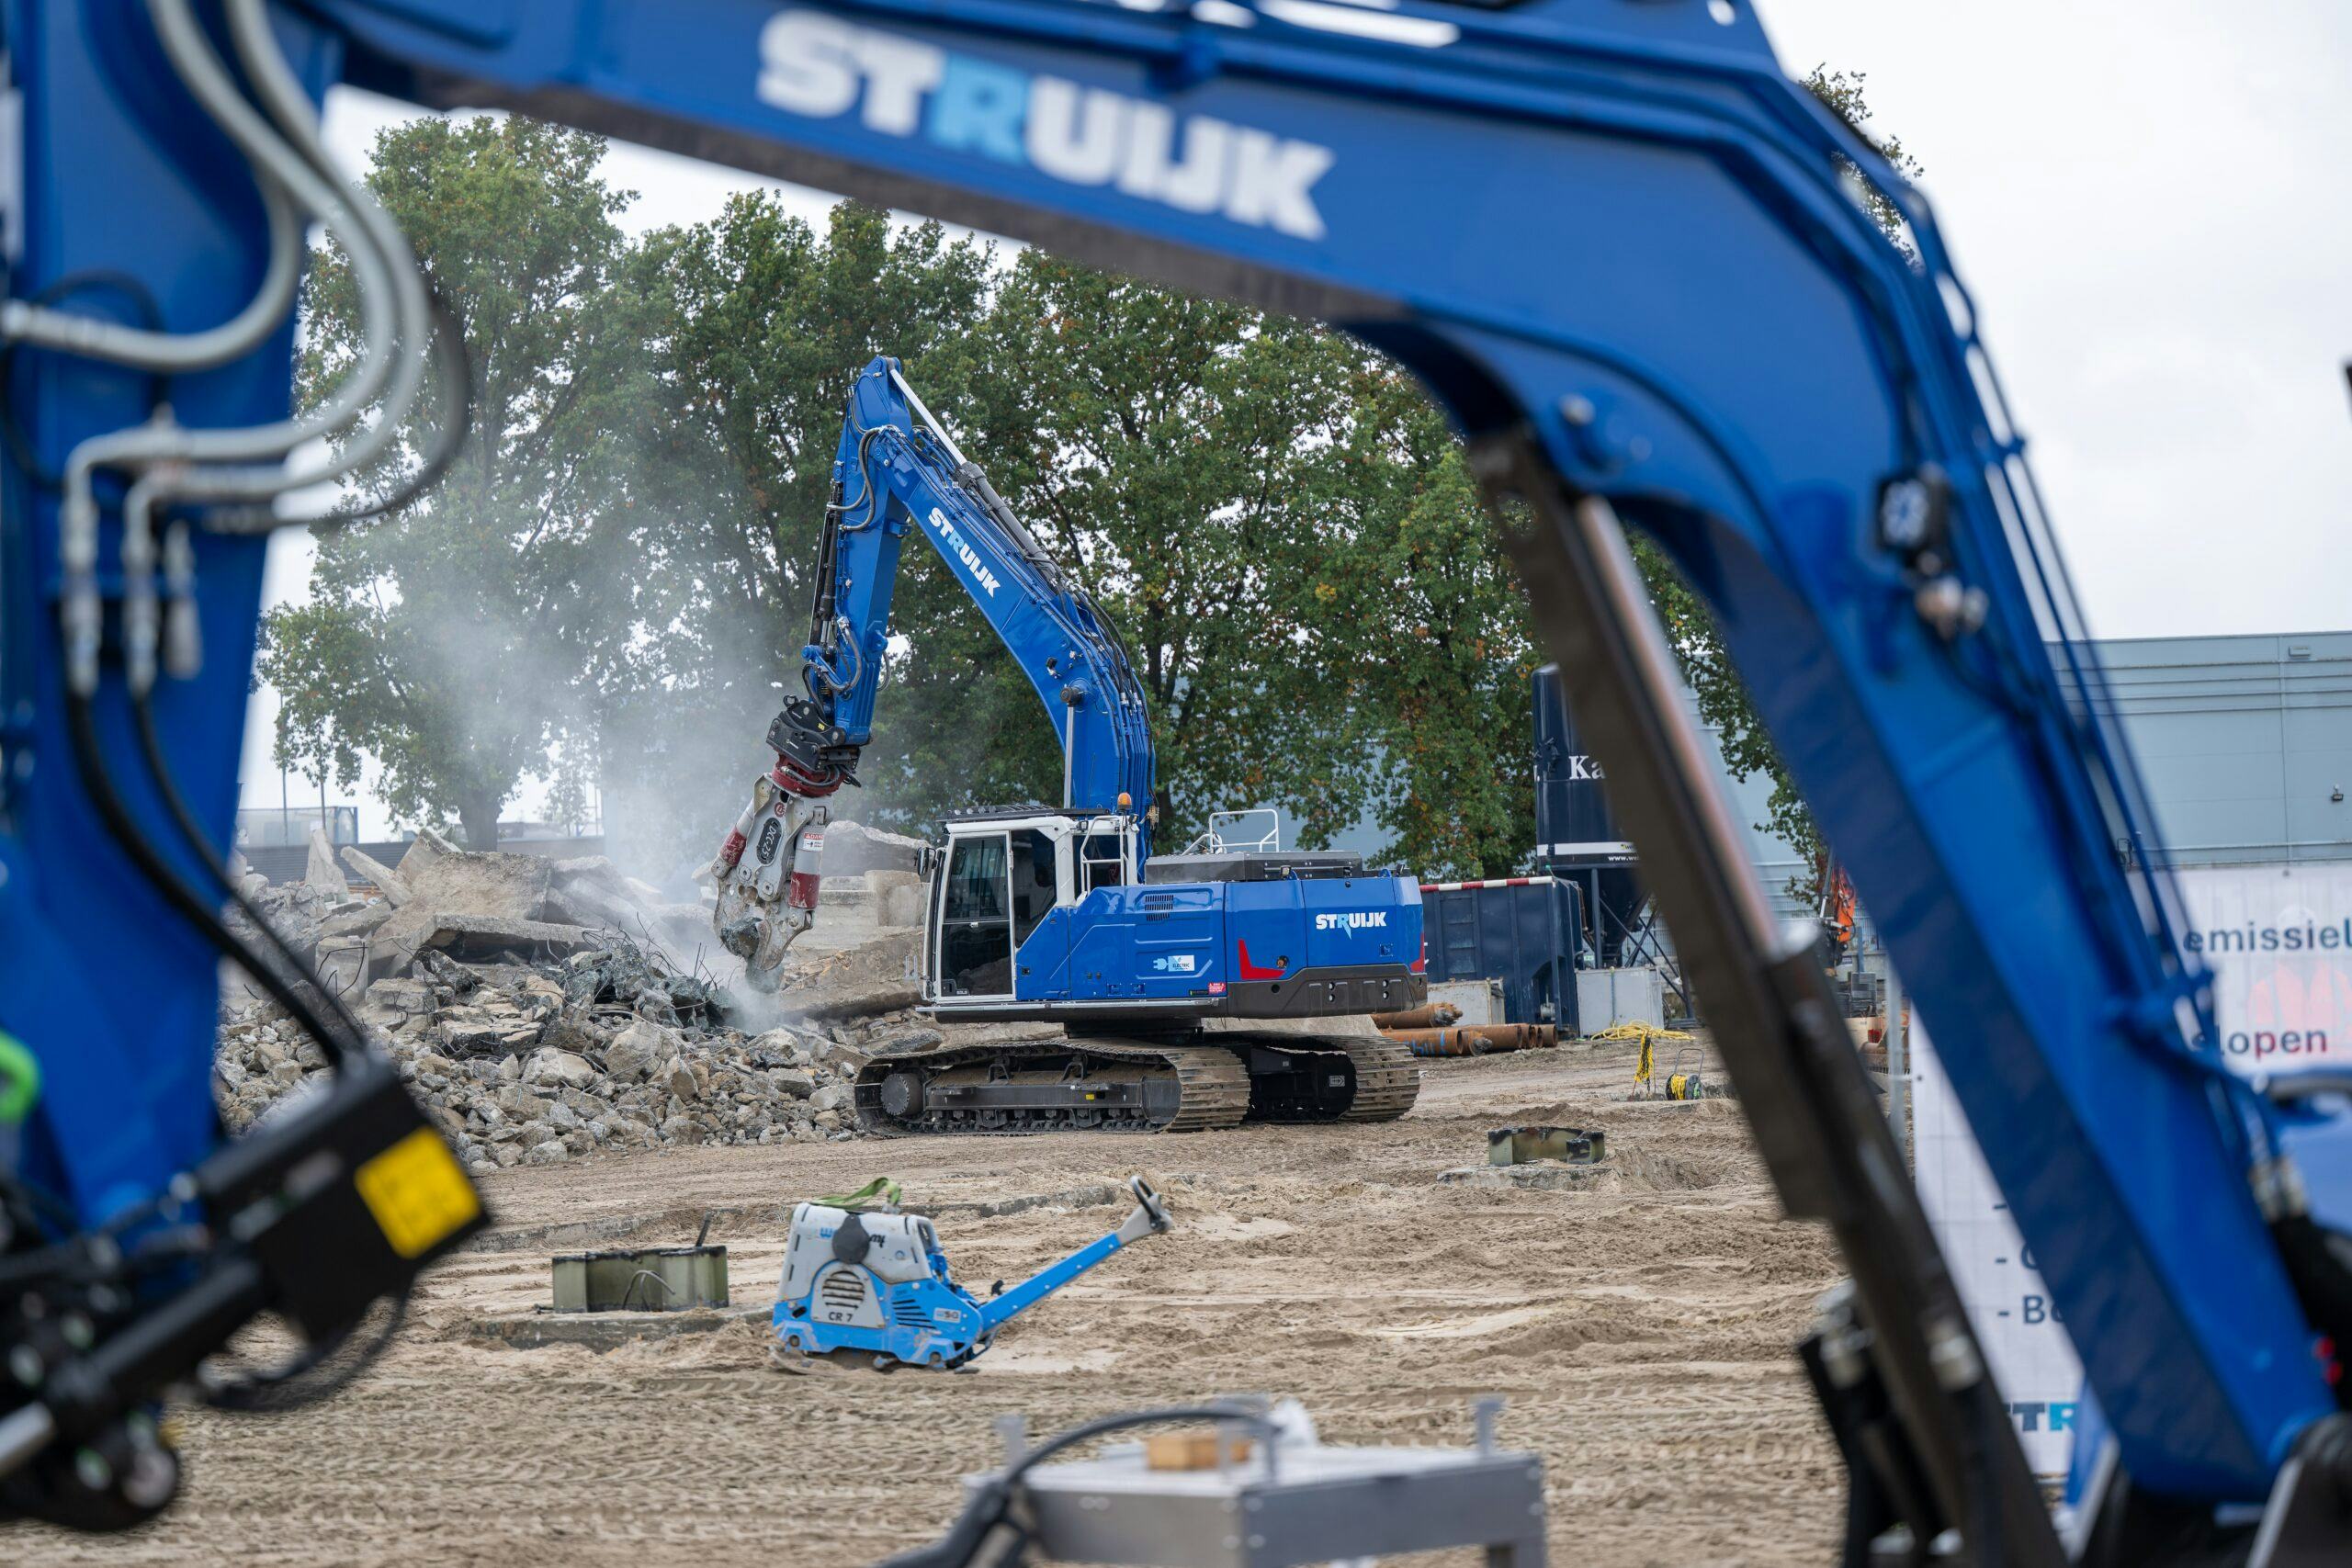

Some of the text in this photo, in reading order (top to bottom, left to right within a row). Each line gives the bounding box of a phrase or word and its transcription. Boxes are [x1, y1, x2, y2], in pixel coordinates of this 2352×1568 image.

[757, 10, 1334, 241] STRUIJK
[928, 507, 1001, 598] STRUIJK
[1316, 912, 1386, 940] STRUIJK
[2221, 1031, 2327, 1062] open
[829, 1312, 854, 1322] CR 7
